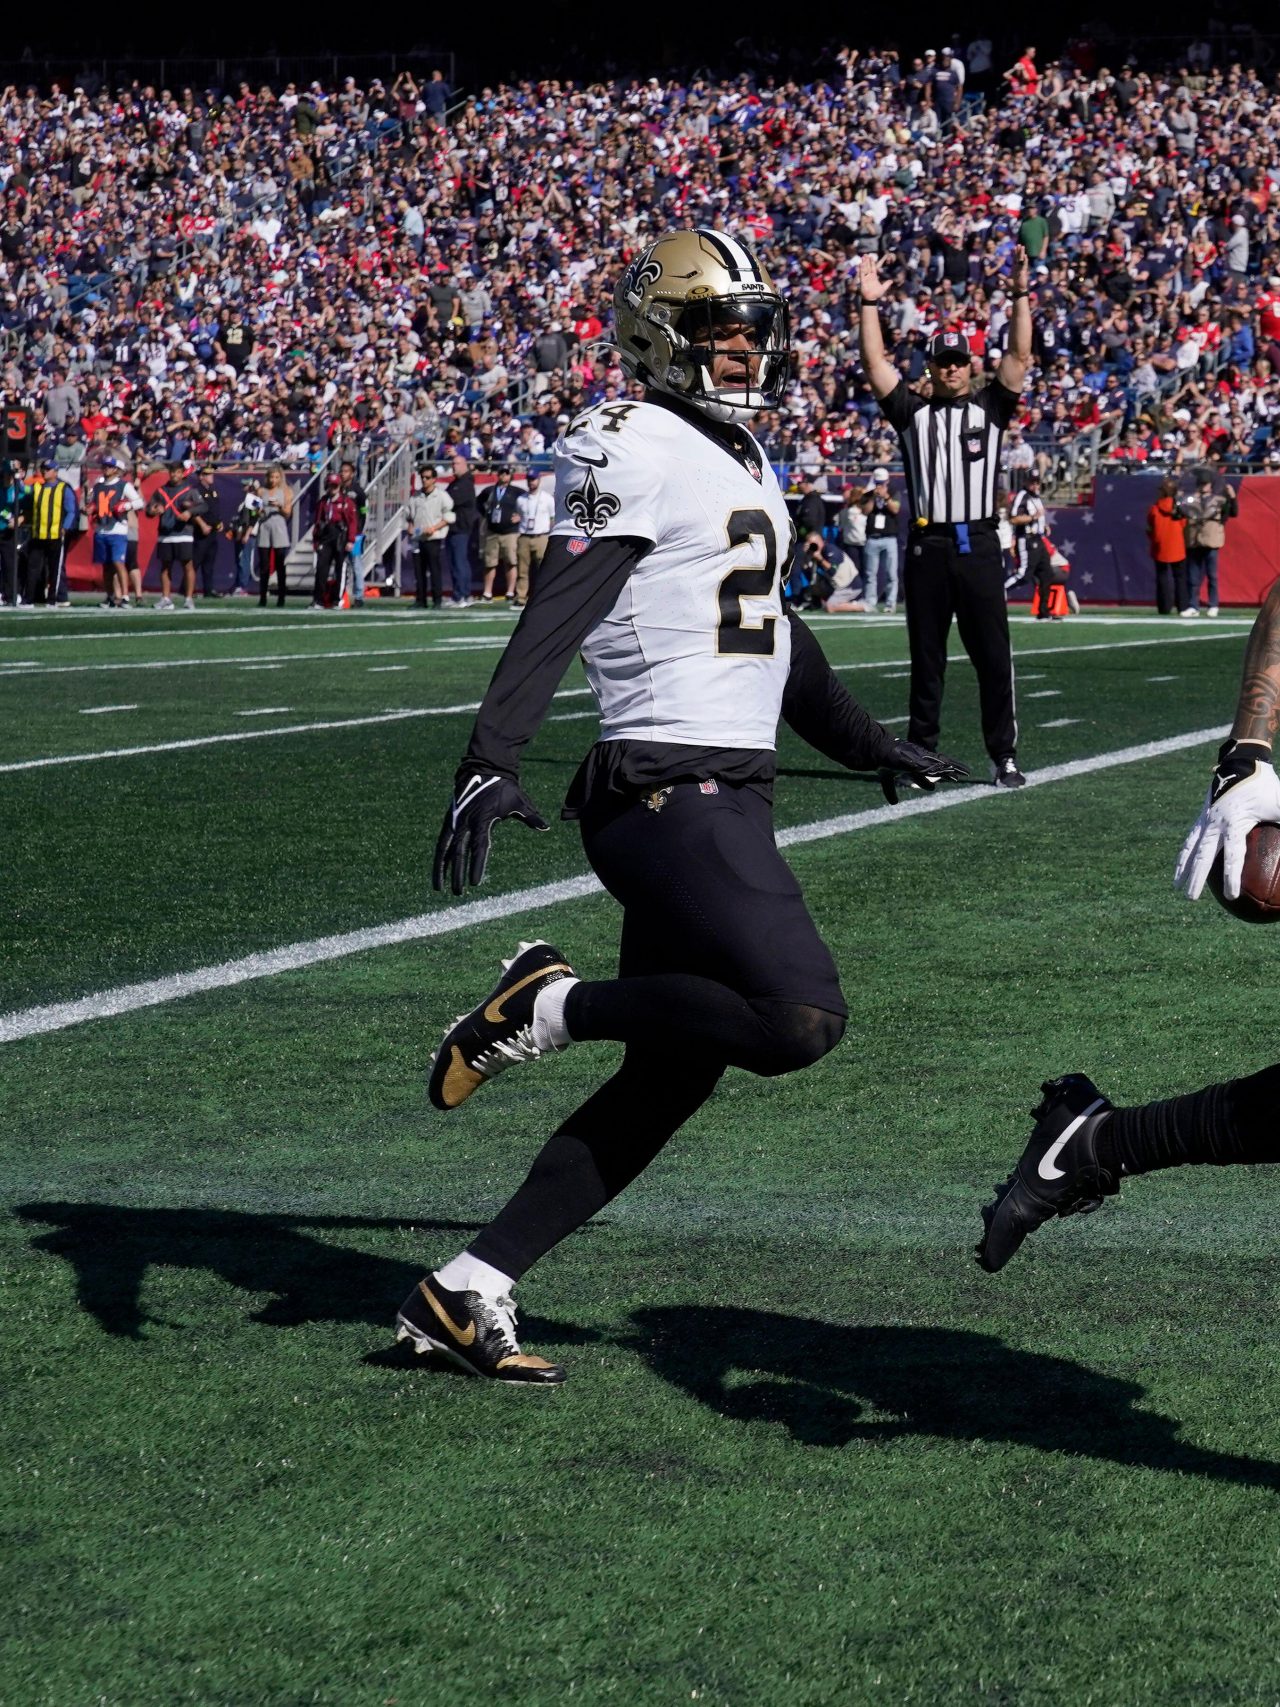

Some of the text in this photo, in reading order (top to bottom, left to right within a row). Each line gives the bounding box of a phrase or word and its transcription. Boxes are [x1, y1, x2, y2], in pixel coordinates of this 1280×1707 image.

[741, 283, 765, 291] SAINTS
[227, 329, 243, 345] 12
[1043, 330, 1056, 347] 9
[7, 412, 27, 440] 3
[714, 506, 797, 659] 2
